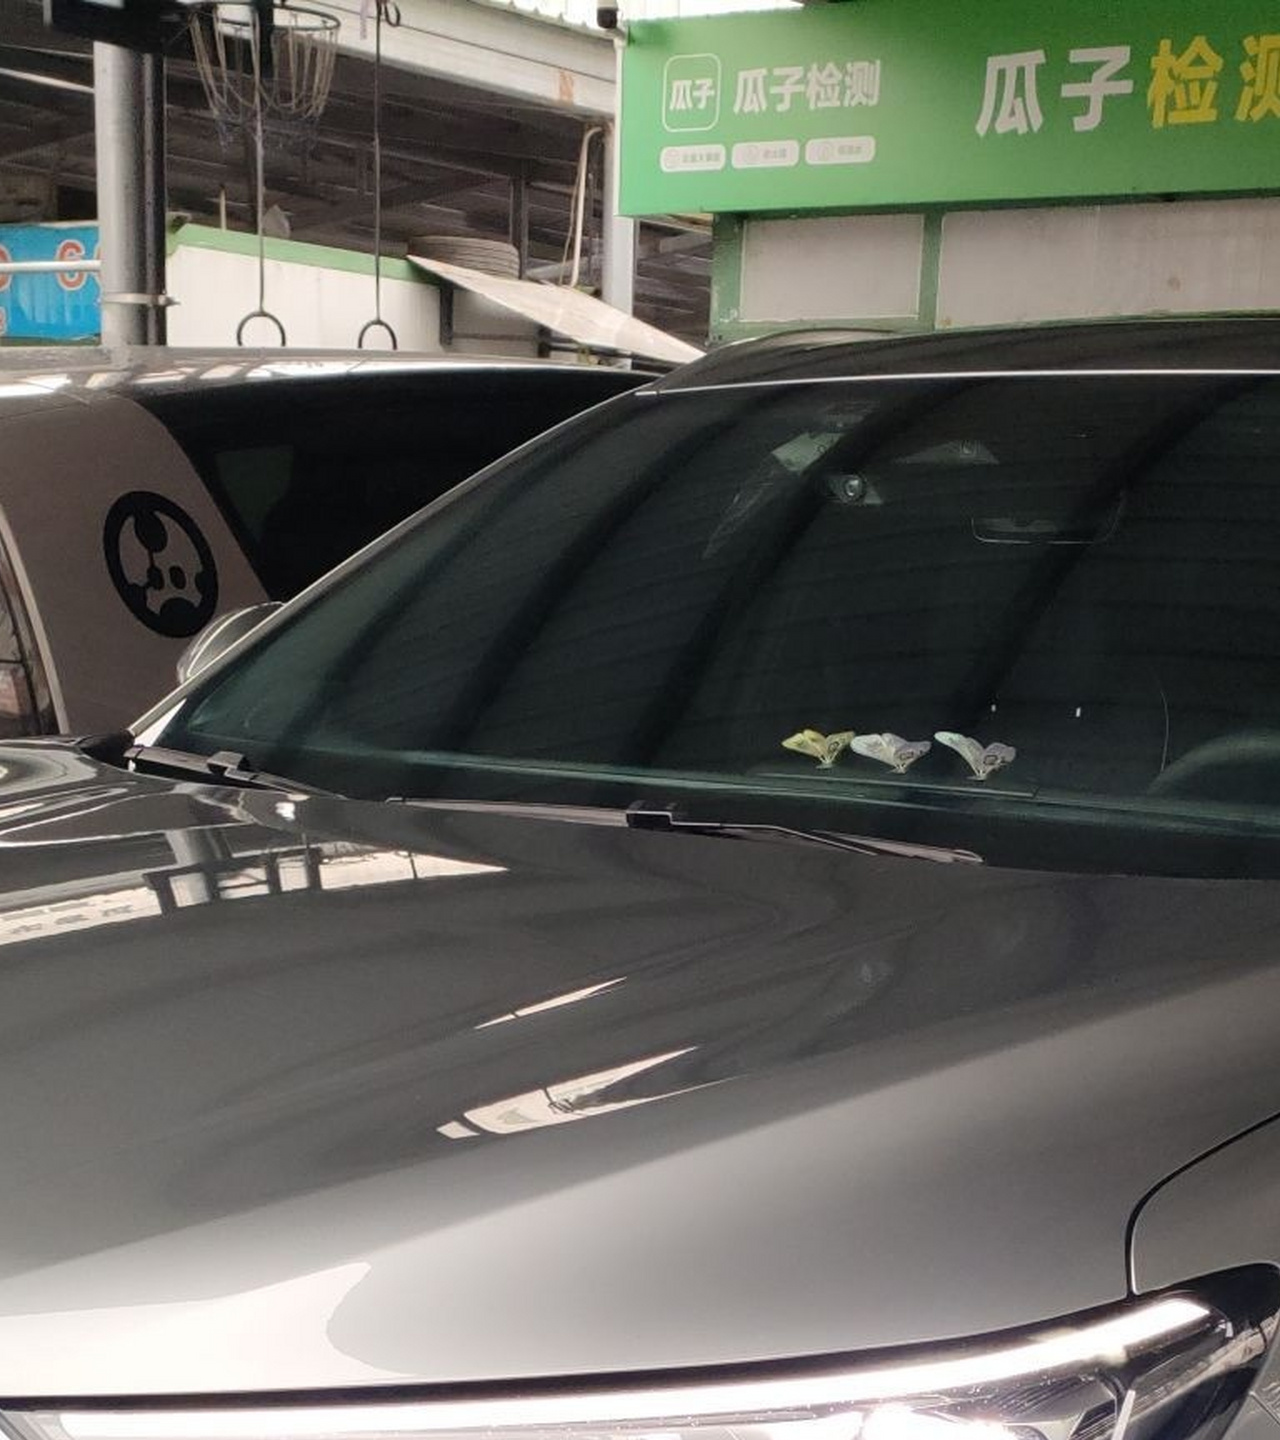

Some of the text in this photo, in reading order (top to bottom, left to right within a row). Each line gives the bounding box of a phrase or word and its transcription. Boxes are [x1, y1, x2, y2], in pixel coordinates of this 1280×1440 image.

[669, 77, 716, 112] 瓜子
[733, 59, 882, 116] 瓜子检测
